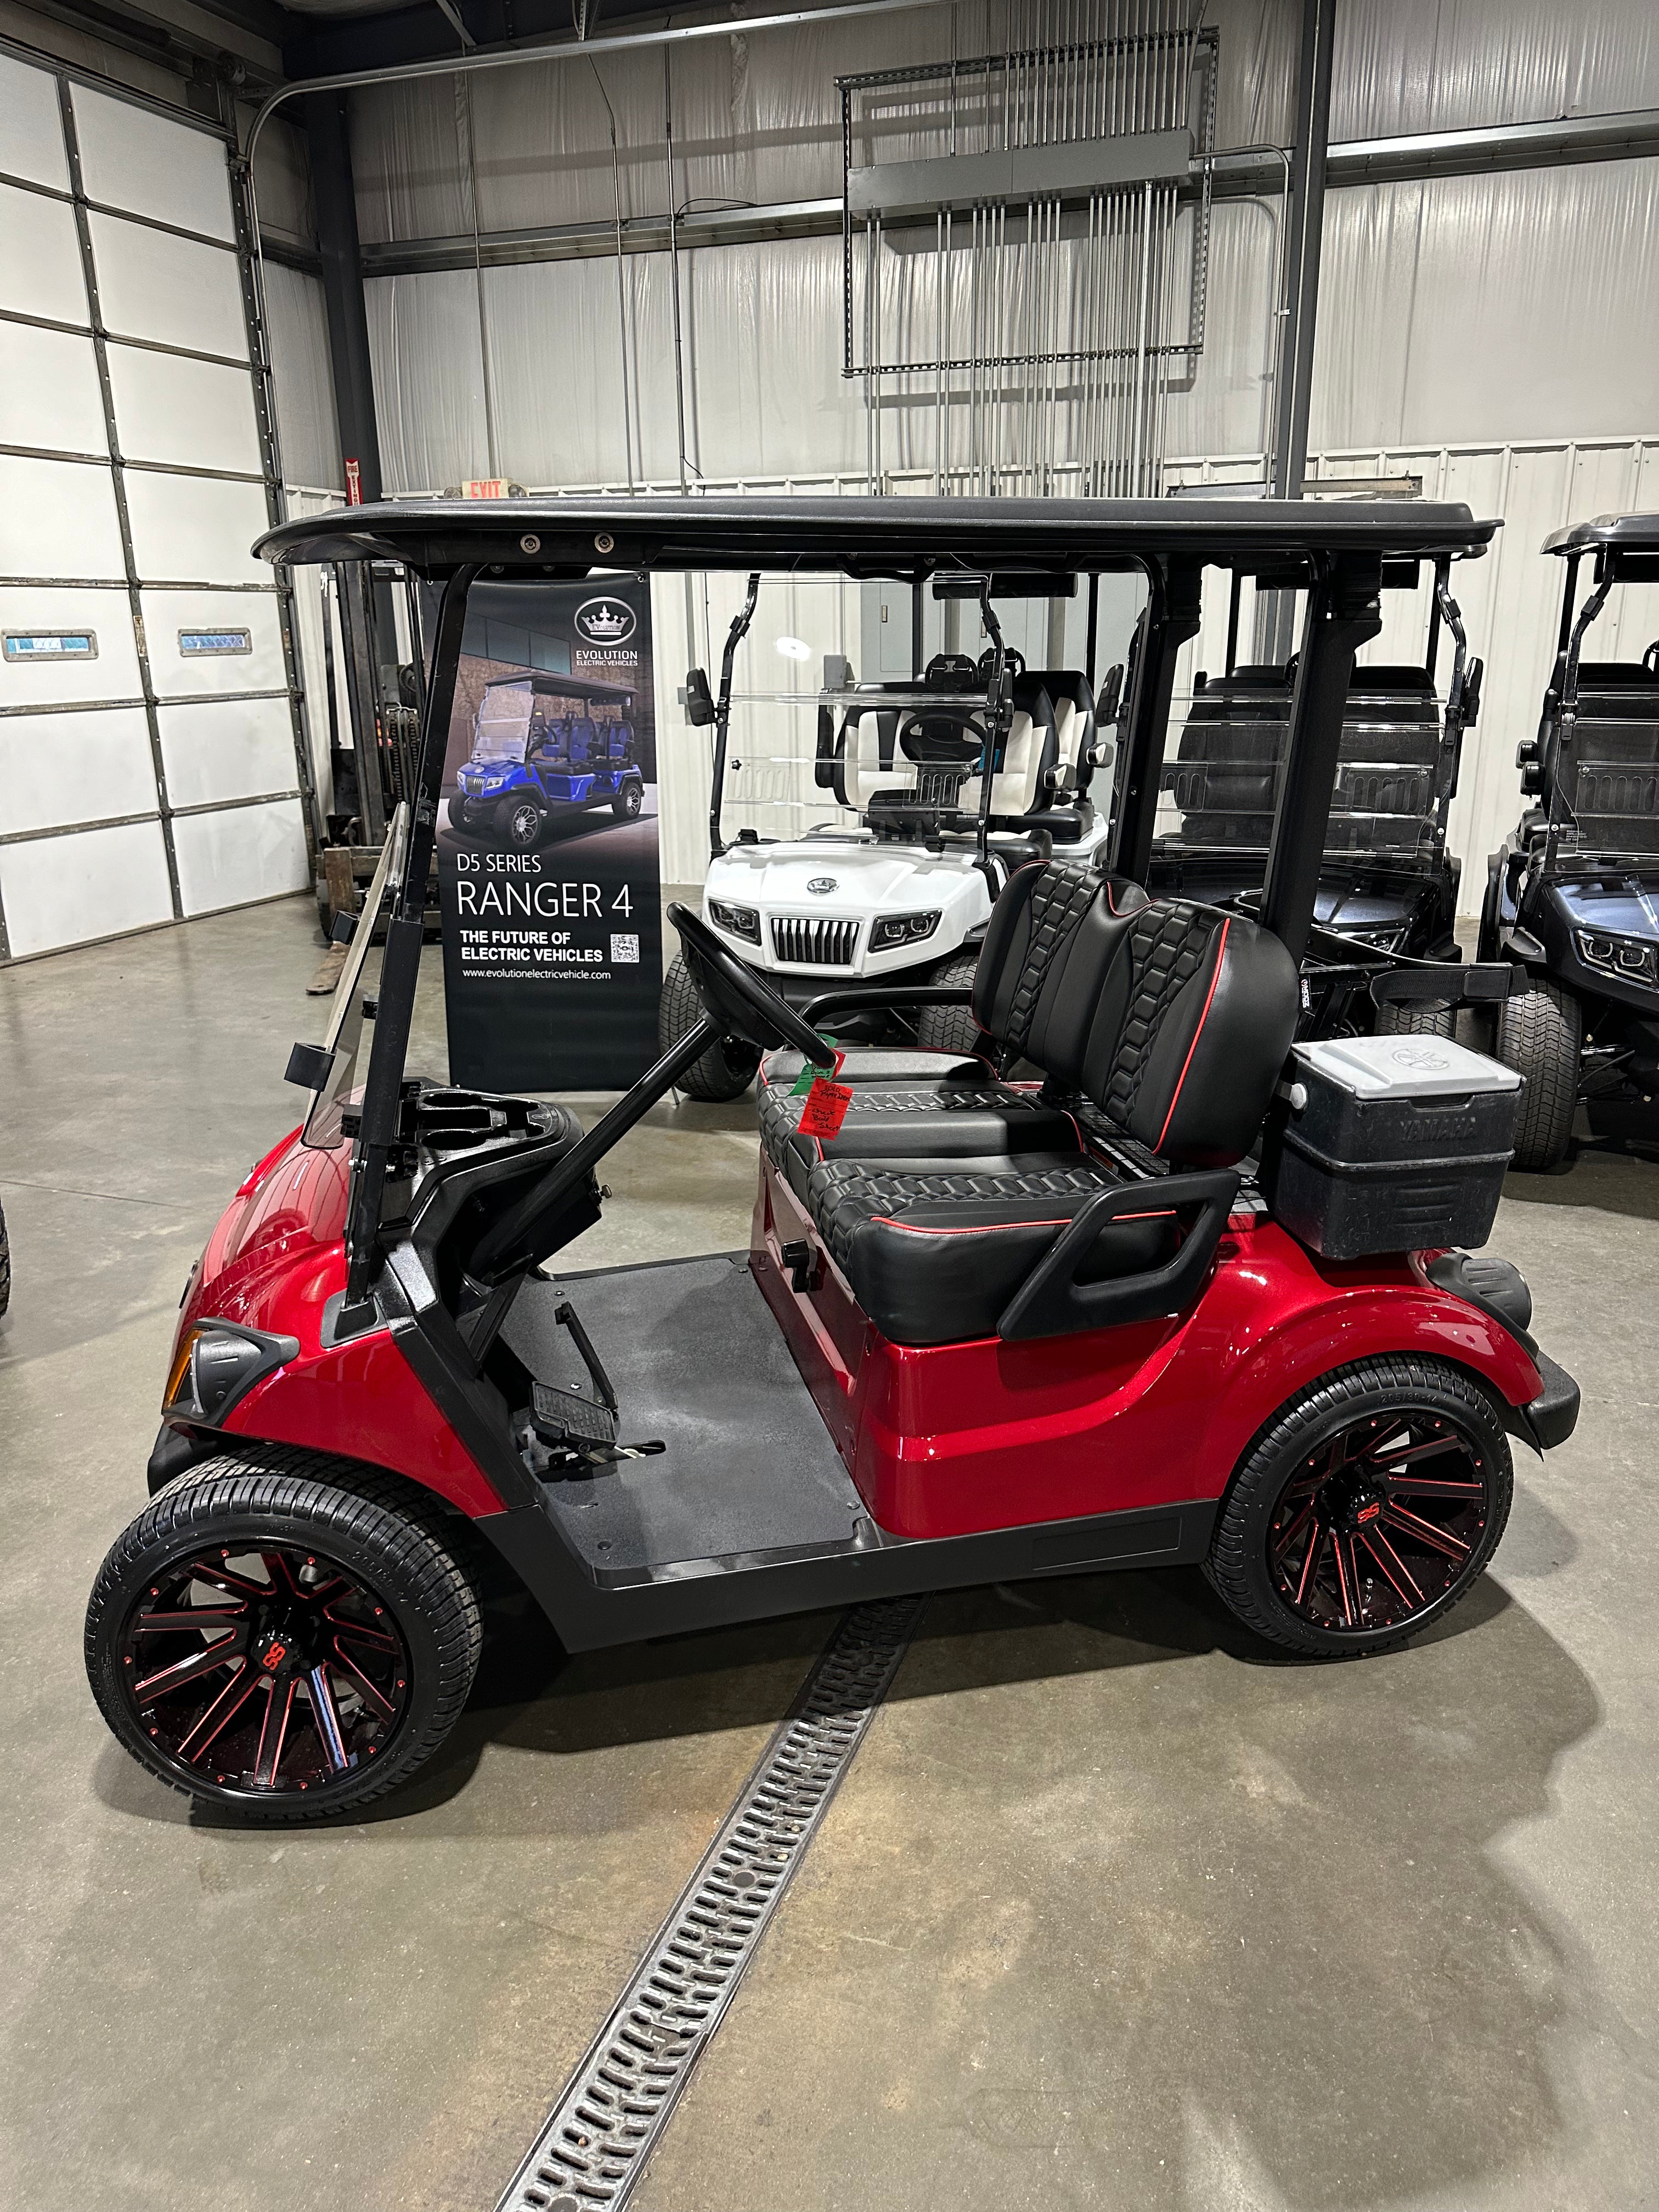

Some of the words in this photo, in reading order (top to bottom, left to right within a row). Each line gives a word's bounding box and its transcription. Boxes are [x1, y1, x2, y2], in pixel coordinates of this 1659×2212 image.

[576, 650, 637, 659] EVOLUTION
[456, 853, 480, 871] D5
[486, 854, 541, 873] SERIES
[457, 881, 602, 917] RANGER
[611, 884, 634, 918] 4
[460, 930, 489, 943] THE
[492, 930, 549, 944] FUTURE
[551, 932, 571, 945] OF
[461, 947, 531, 961] ELECTRIC
[534, 948, 603, 962] VEHICLES
[462, 968, 611, 979] www.evolutionelectricvehicle.com
